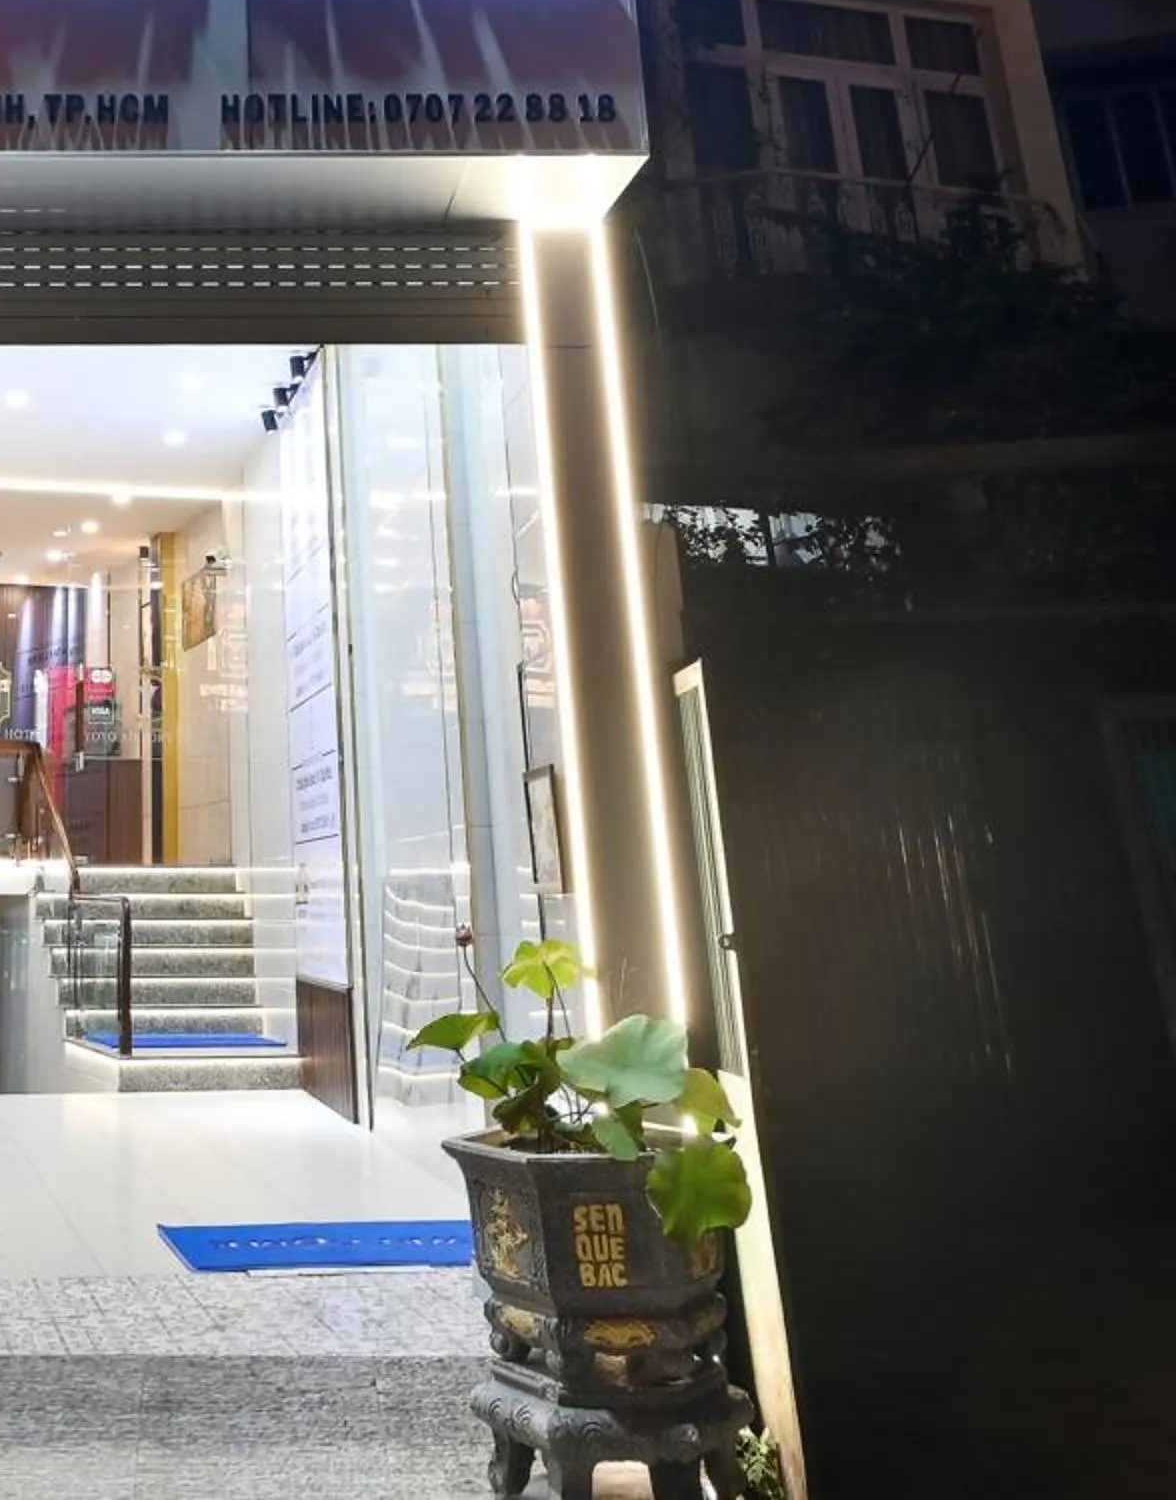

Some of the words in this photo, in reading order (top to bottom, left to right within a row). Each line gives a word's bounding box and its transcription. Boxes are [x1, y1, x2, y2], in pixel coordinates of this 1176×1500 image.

[220, 93, 377, 124] HOTLINE:
[473, 93, 516, 124] 22
[577, 92, 618, 124] 18
